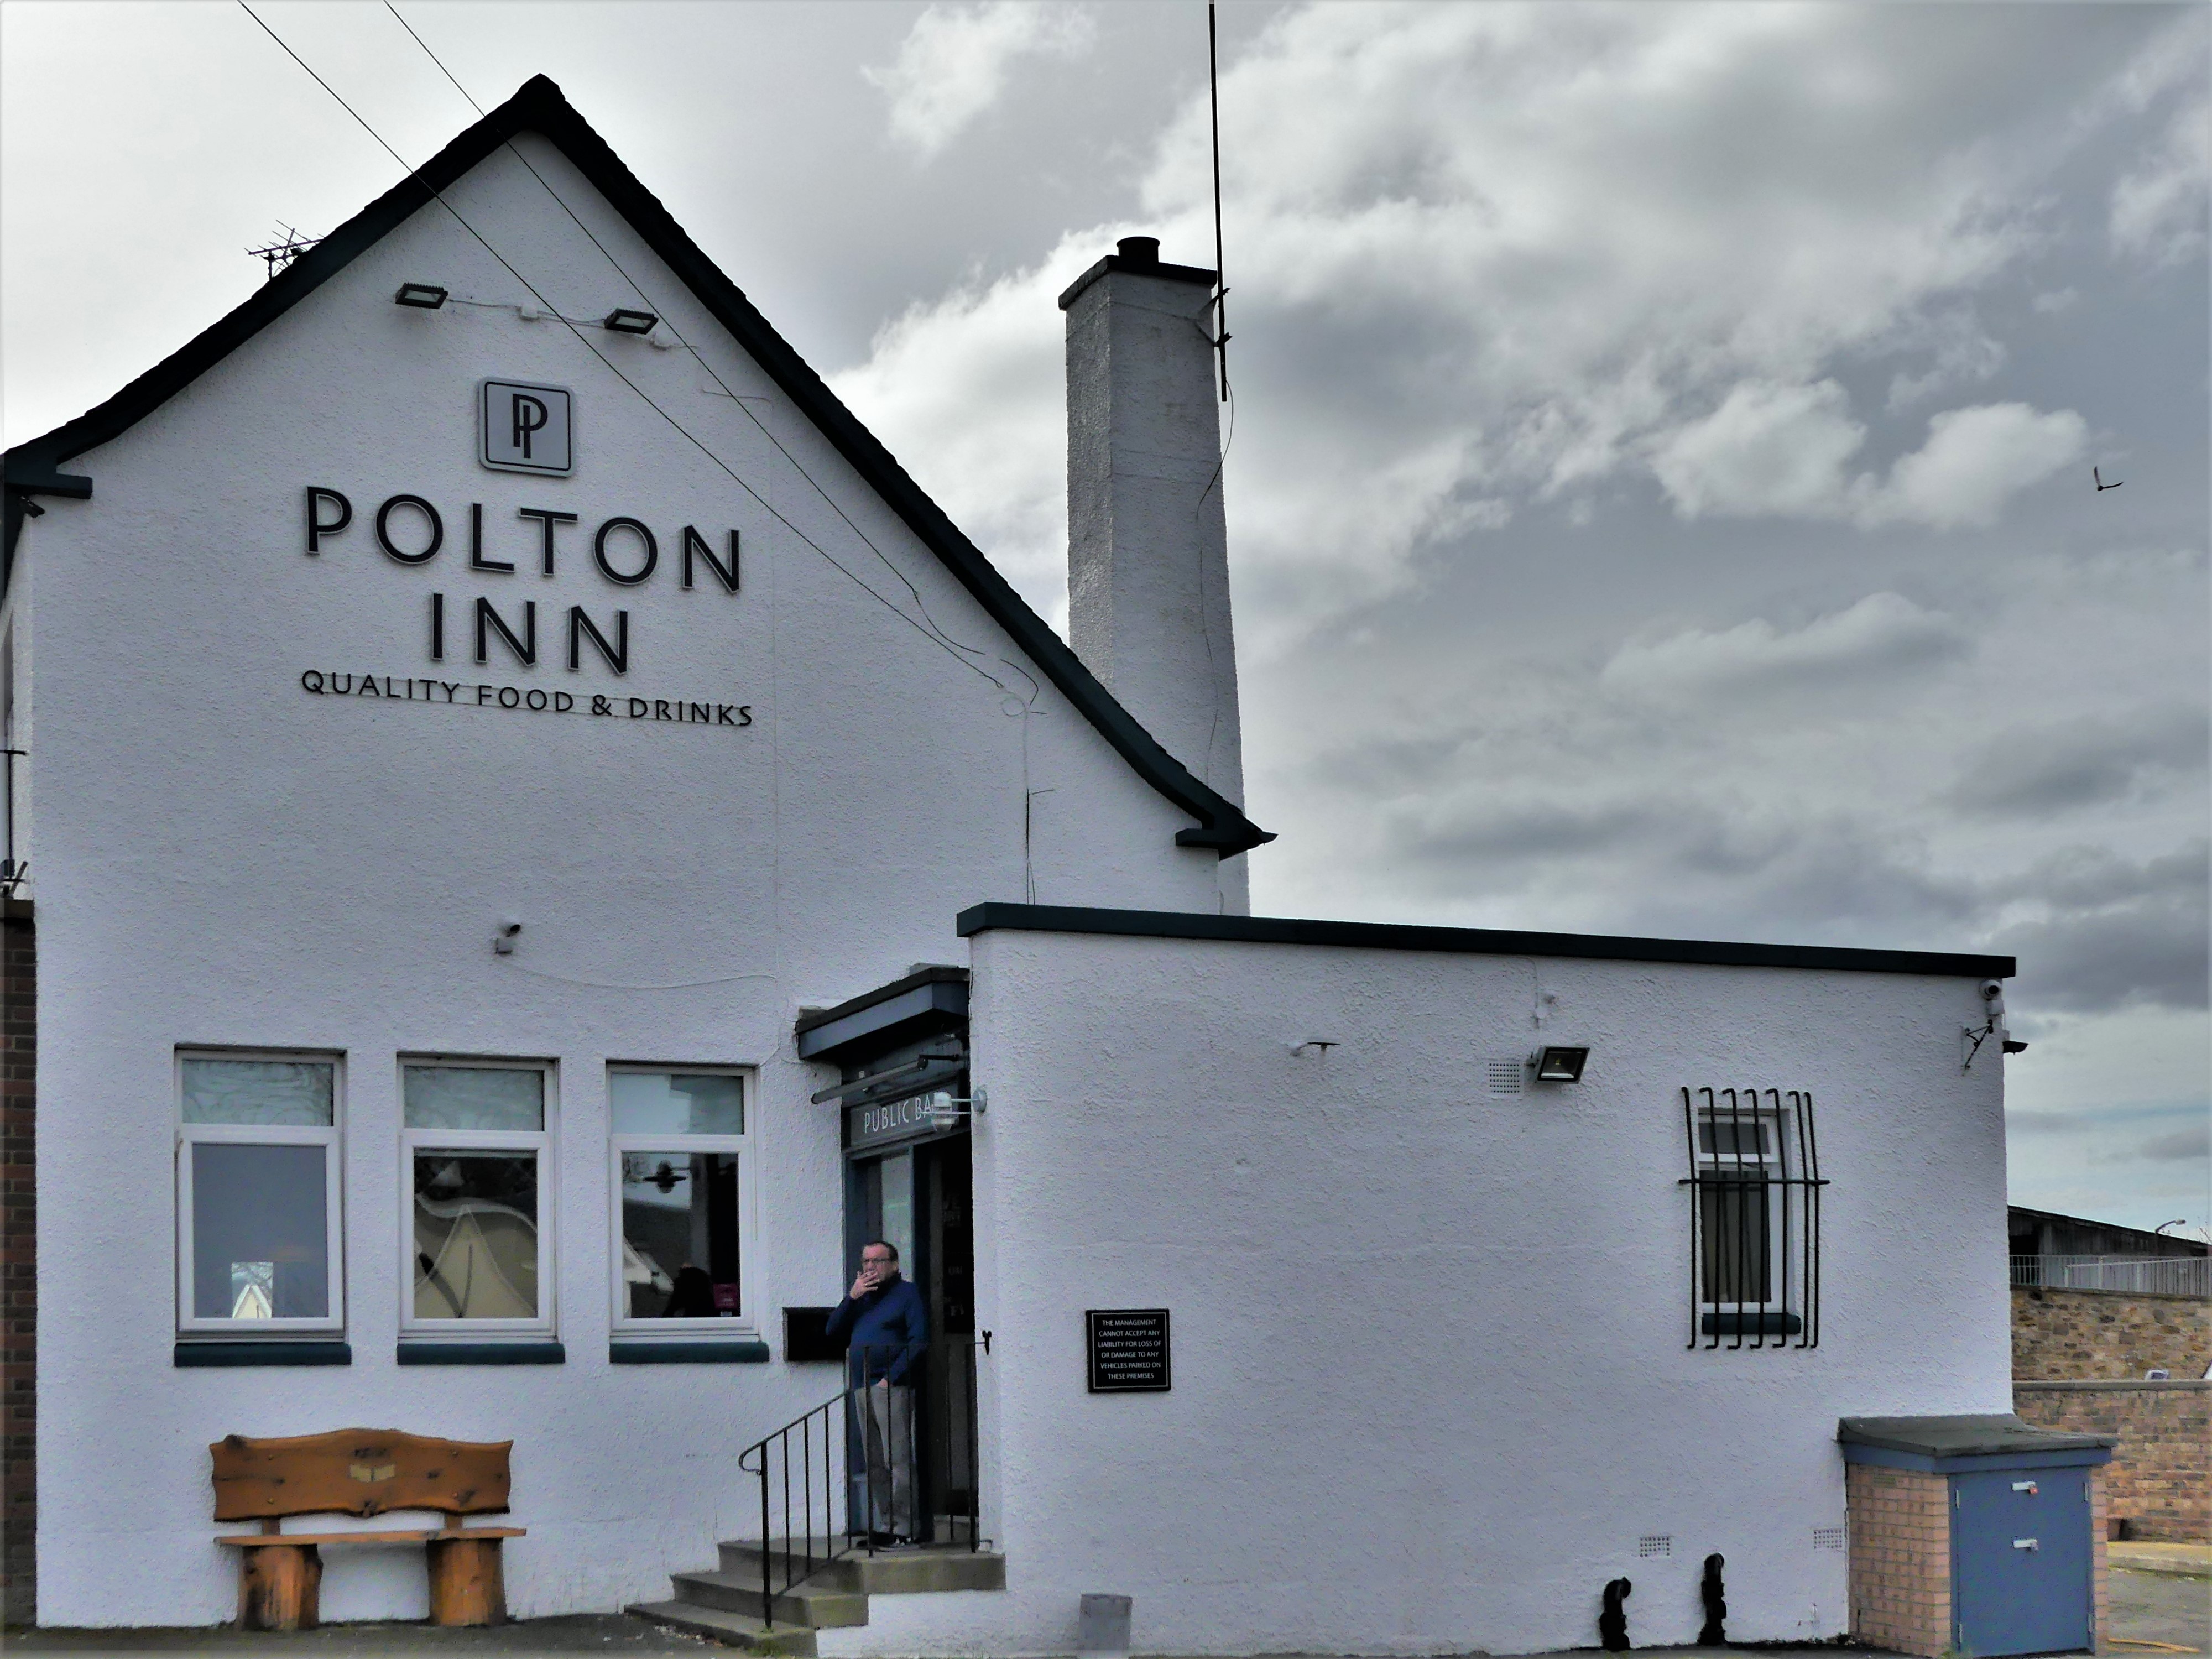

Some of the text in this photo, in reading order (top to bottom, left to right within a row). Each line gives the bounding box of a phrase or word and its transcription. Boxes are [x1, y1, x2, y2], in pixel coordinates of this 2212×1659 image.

[307, 486, 740, 594] POLTON
[431, 592, 629, 675] INN
[302, 670, 753, 726] QUALITY FOOD & DRINKS
[864, 1094, 936, 1133] PUBLIC BA
